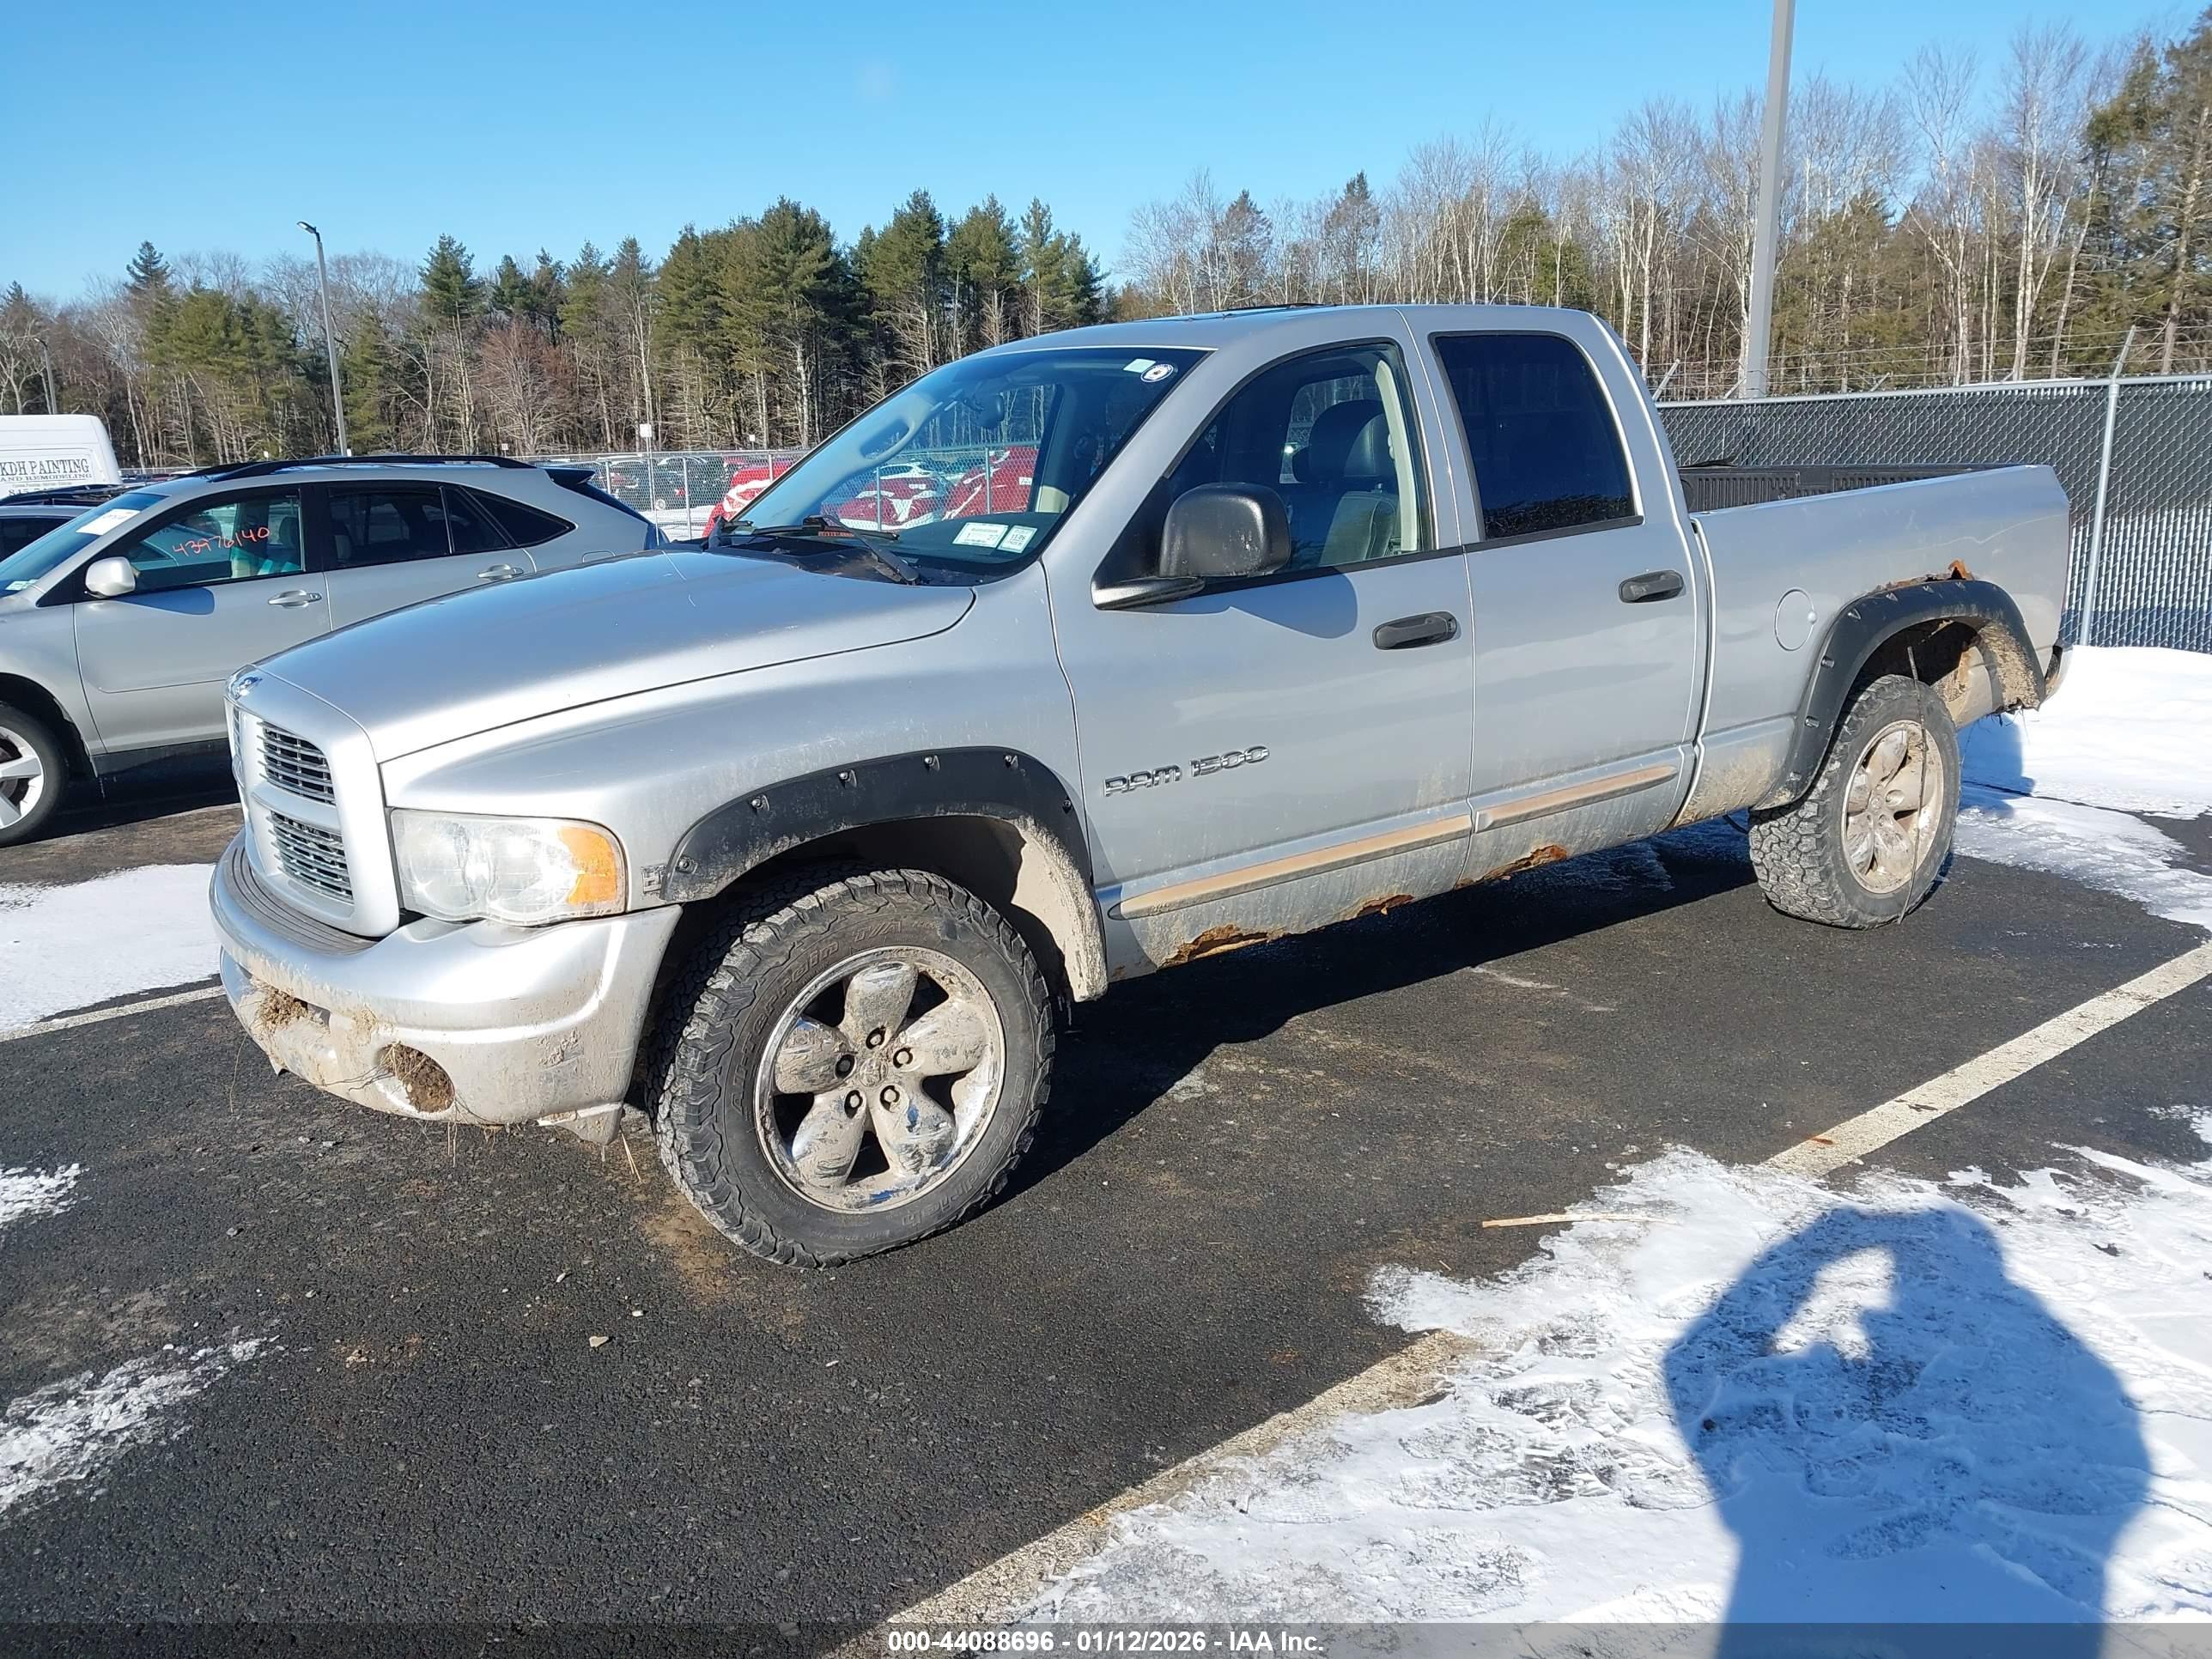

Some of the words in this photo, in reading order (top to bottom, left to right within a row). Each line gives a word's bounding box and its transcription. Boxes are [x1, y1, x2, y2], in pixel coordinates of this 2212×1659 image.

[0, 461, 27, 476] KDH
[29, 459, 89, 475] PAINTING
[1103, 764, 1182, 798] RAM
[1188, 745, 1270, 777] 1500
